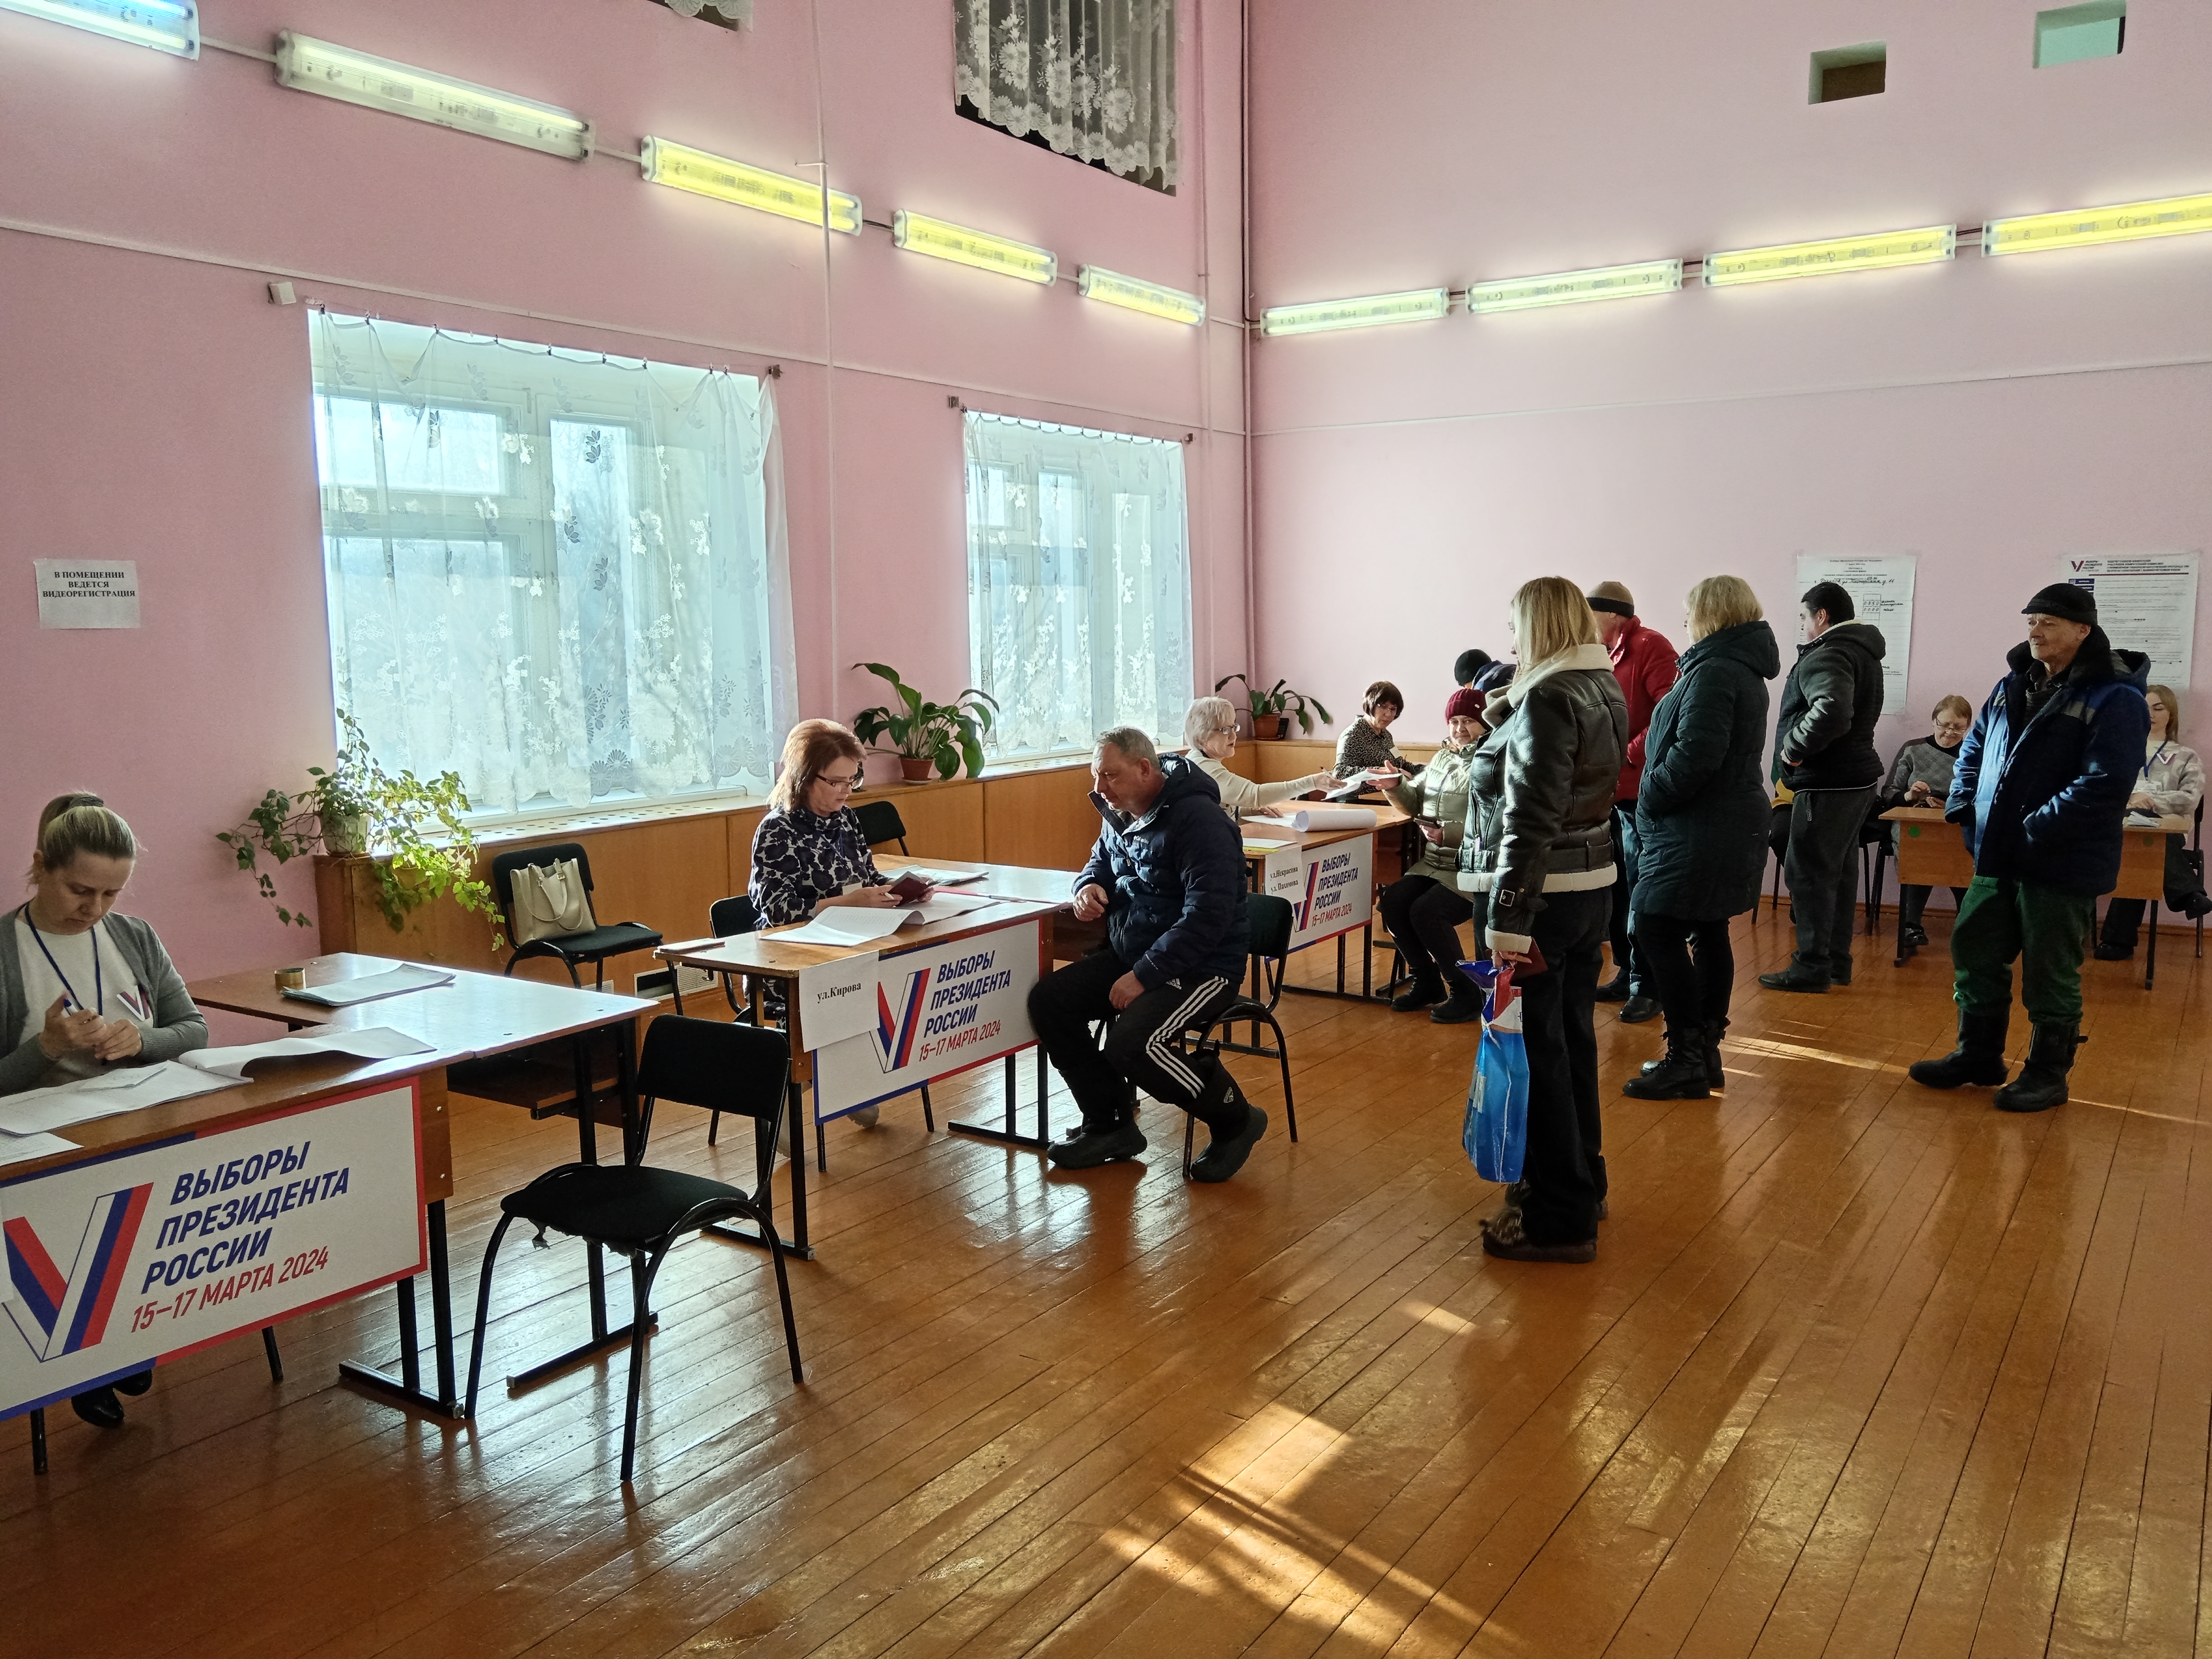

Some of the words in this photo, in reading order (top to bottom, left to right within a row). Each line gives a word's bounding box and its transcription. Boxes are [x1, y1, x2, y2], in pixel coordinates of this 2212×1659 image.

[68, 581, 109, 589] ВЕДЕТСЯ
[1318, 867, 1358, 892] ПРЕЗИДЕНТА
[1321, 852, 1351, 873] ВЫБОРЫ
[1314, 890, 1341, 911] РОССИИ
[1324, 906, 1341, 923] МАРТА
[1341, 902, 1352, 917] 2024
[936, 950, 995, 984] ВЫБОРЫ
[817, 983, 861, 1004] ул.Кирова
[930, 969, 1011, 1011] ПРЕЗИДЕНТА
[923, 1004, 978, 1038] РОССИИ
[946, 1027, 978, 1053] МАРТА
[979, 1019, 1001, 1041] 2024
[170, 1140, 311, 1206] ВЫБОРЫ
[155, 1167, 349, 1250] ПРЕЗИДЕНТА
[141, 1227, 273, 1295] РОССИИ
[198, 1262, 275, 1311] МАРТА
[278, 1245, 329, 1284] 2024
